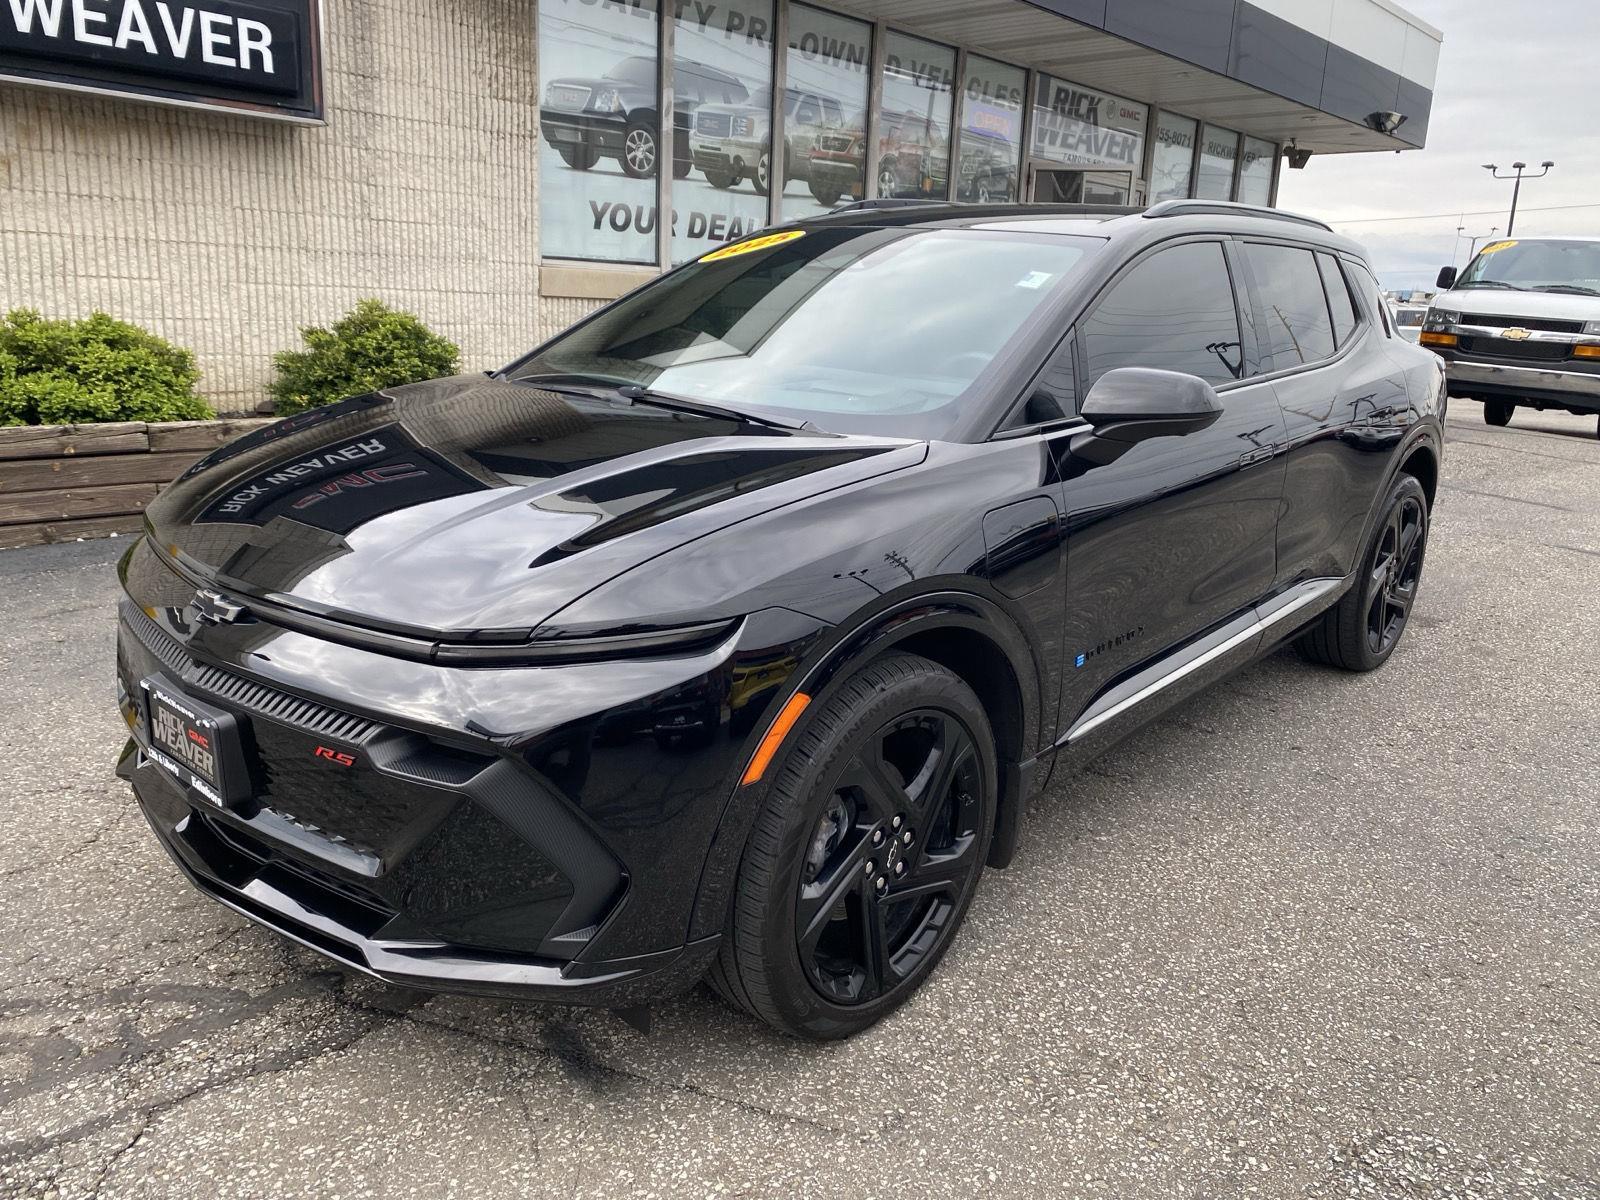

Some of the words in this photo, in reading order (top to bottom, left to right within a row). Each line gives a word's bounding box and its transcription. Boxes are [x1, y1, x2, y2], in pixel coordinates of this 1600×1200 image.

[8, 0, 274, 74] WEAVER
[1053, 86, 1102, 127] RICK
[1120, 107, 1141, 122] GMC
[1037, 128, 1138, 165] WEAVER
[1157, 127, 1192, 148] 55-8071
[158, 706, 184, 735] RICK
[153, 718, 214, 775] WEAVER
[188, 728, 209, 749] GMC
[315, 746, 356, 767] RS
